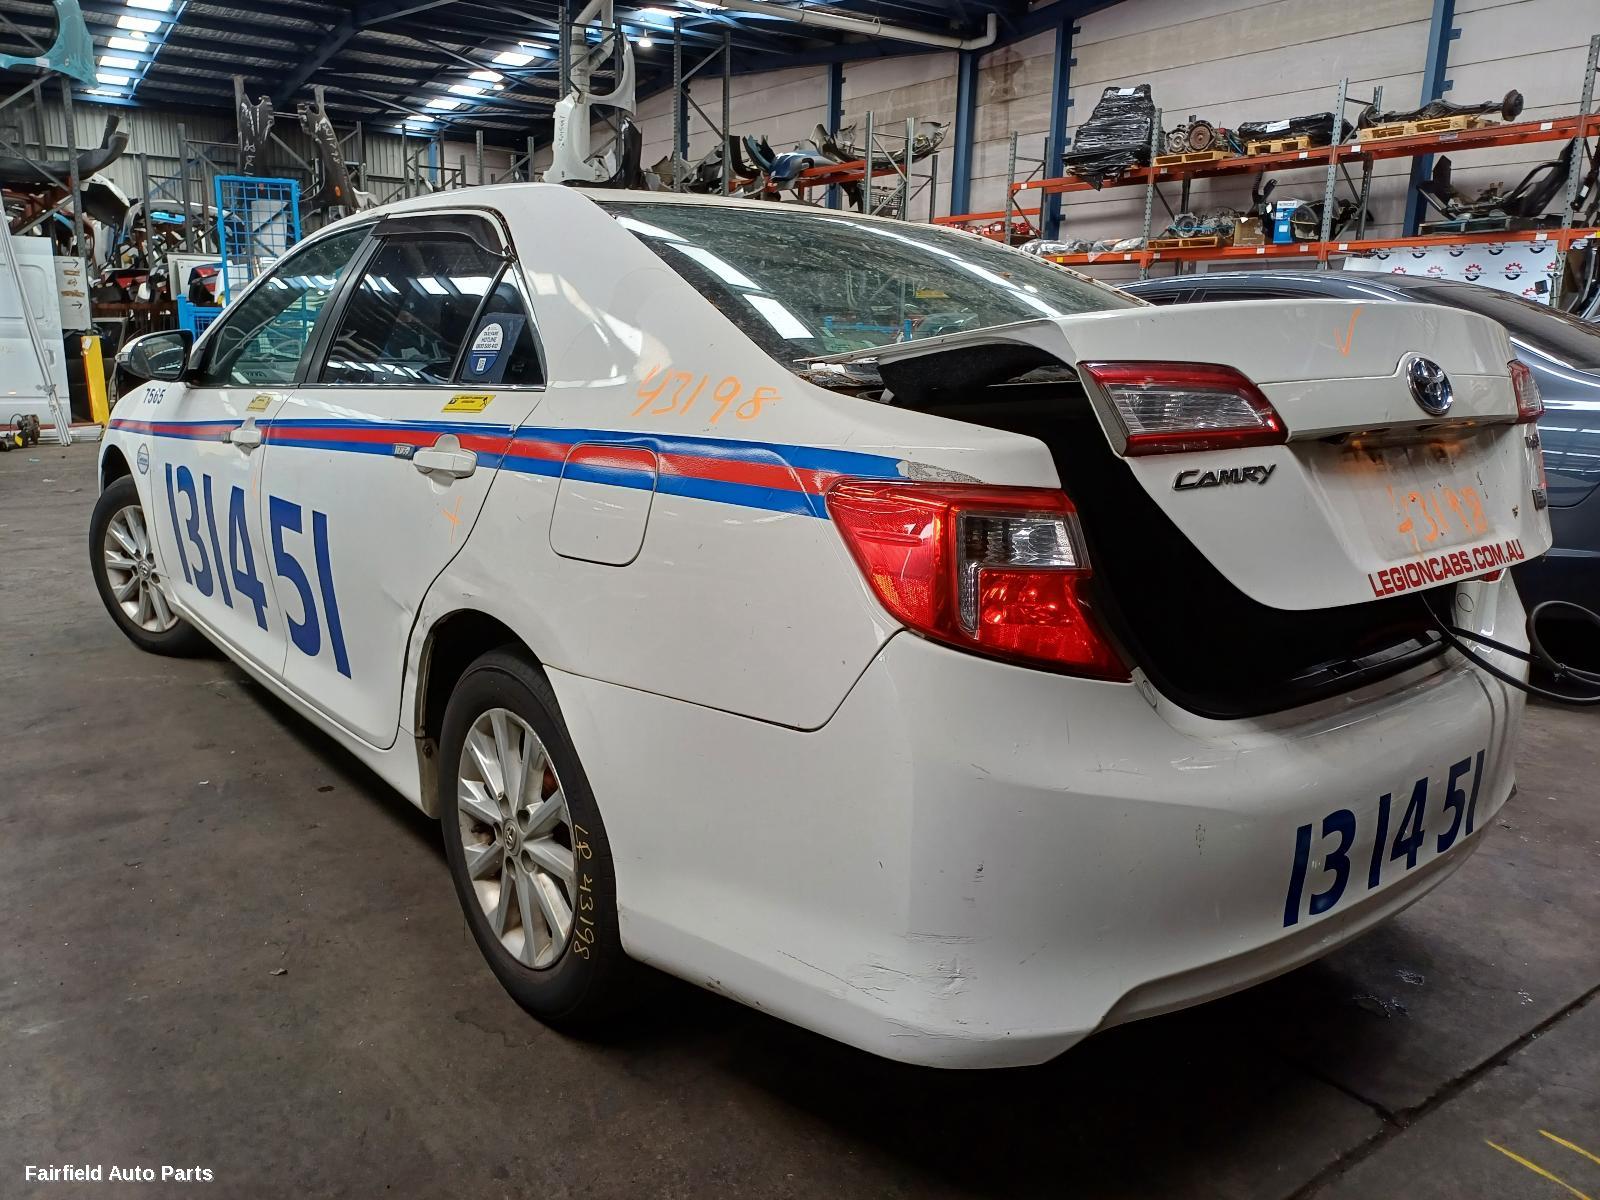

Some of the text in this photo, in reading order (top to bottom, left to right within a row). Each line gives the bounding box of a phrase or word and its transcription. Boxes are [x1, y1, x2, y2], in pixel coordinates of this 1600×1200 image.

[143, 387, 167, 405] 7565
[630, 362, 785, 425] 43198
[1172, 463, 1277, 491] CAMRY
[1367, 538, 1526, 598] LEGIONCABS.COM.AU
